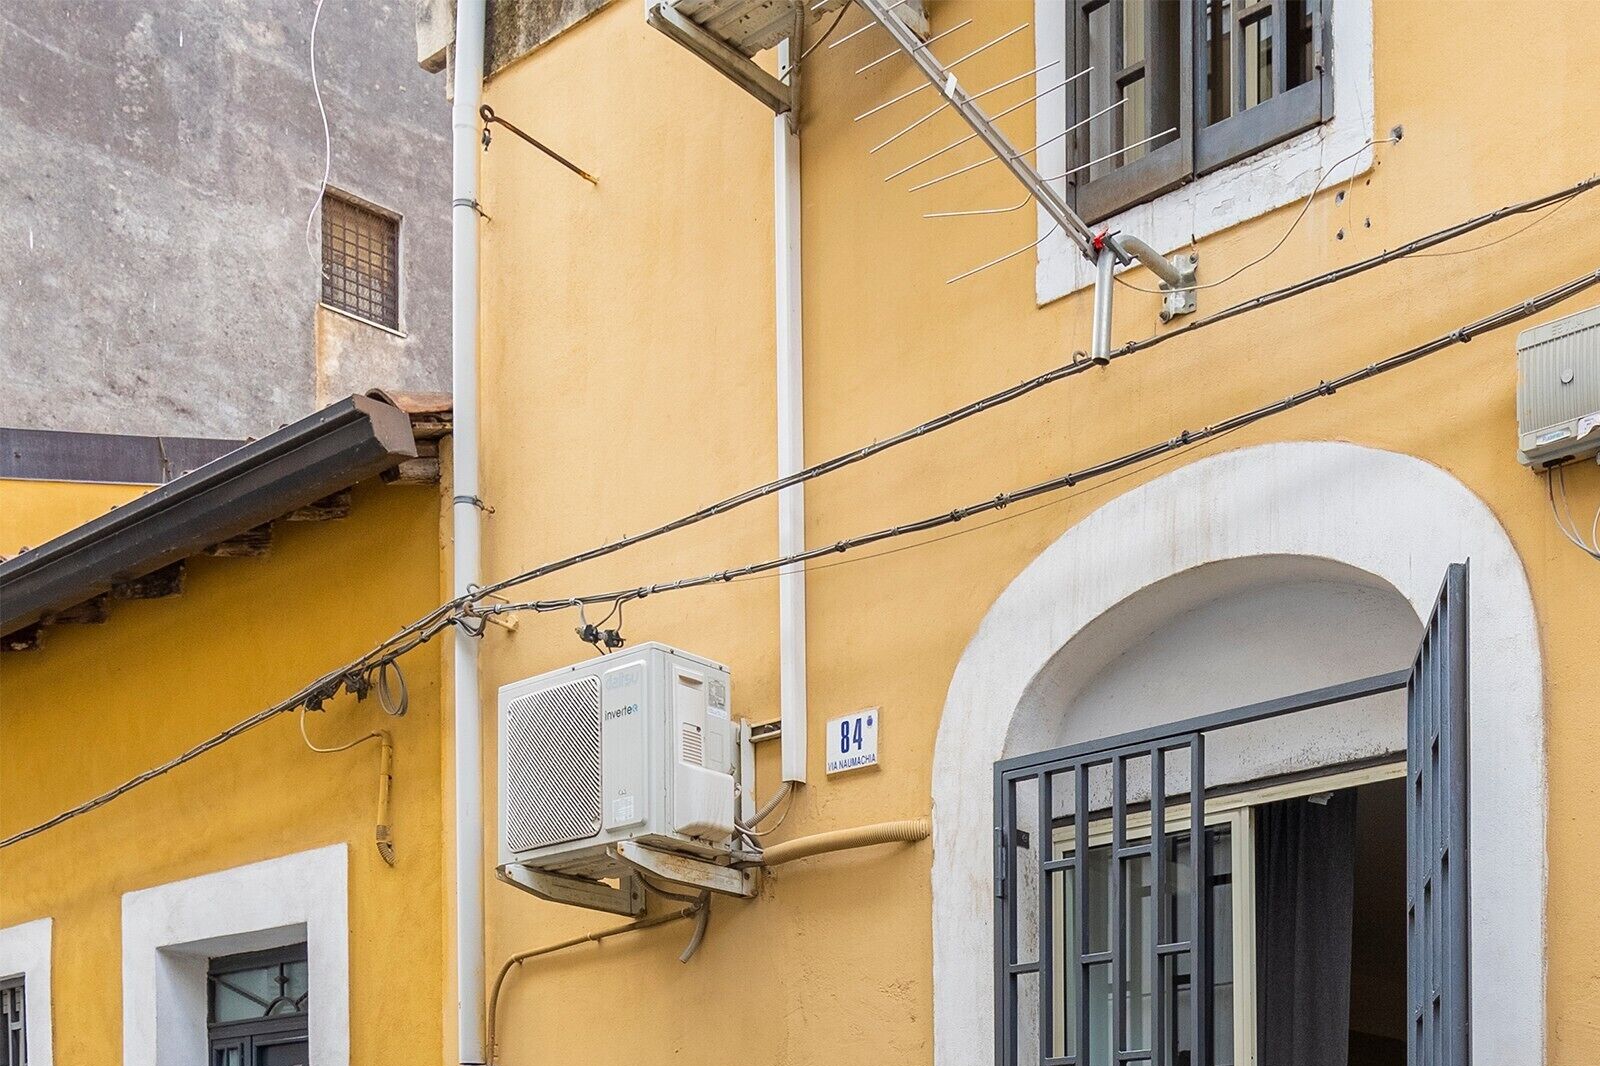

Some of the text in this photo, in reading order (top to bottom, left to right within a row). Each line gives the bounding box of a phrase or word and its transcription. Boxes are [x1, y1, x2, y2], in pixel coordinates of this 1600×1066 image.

[840, 717, 863, 754] 84
[827, 753, 876, 771] VIA NAUMACHIA
